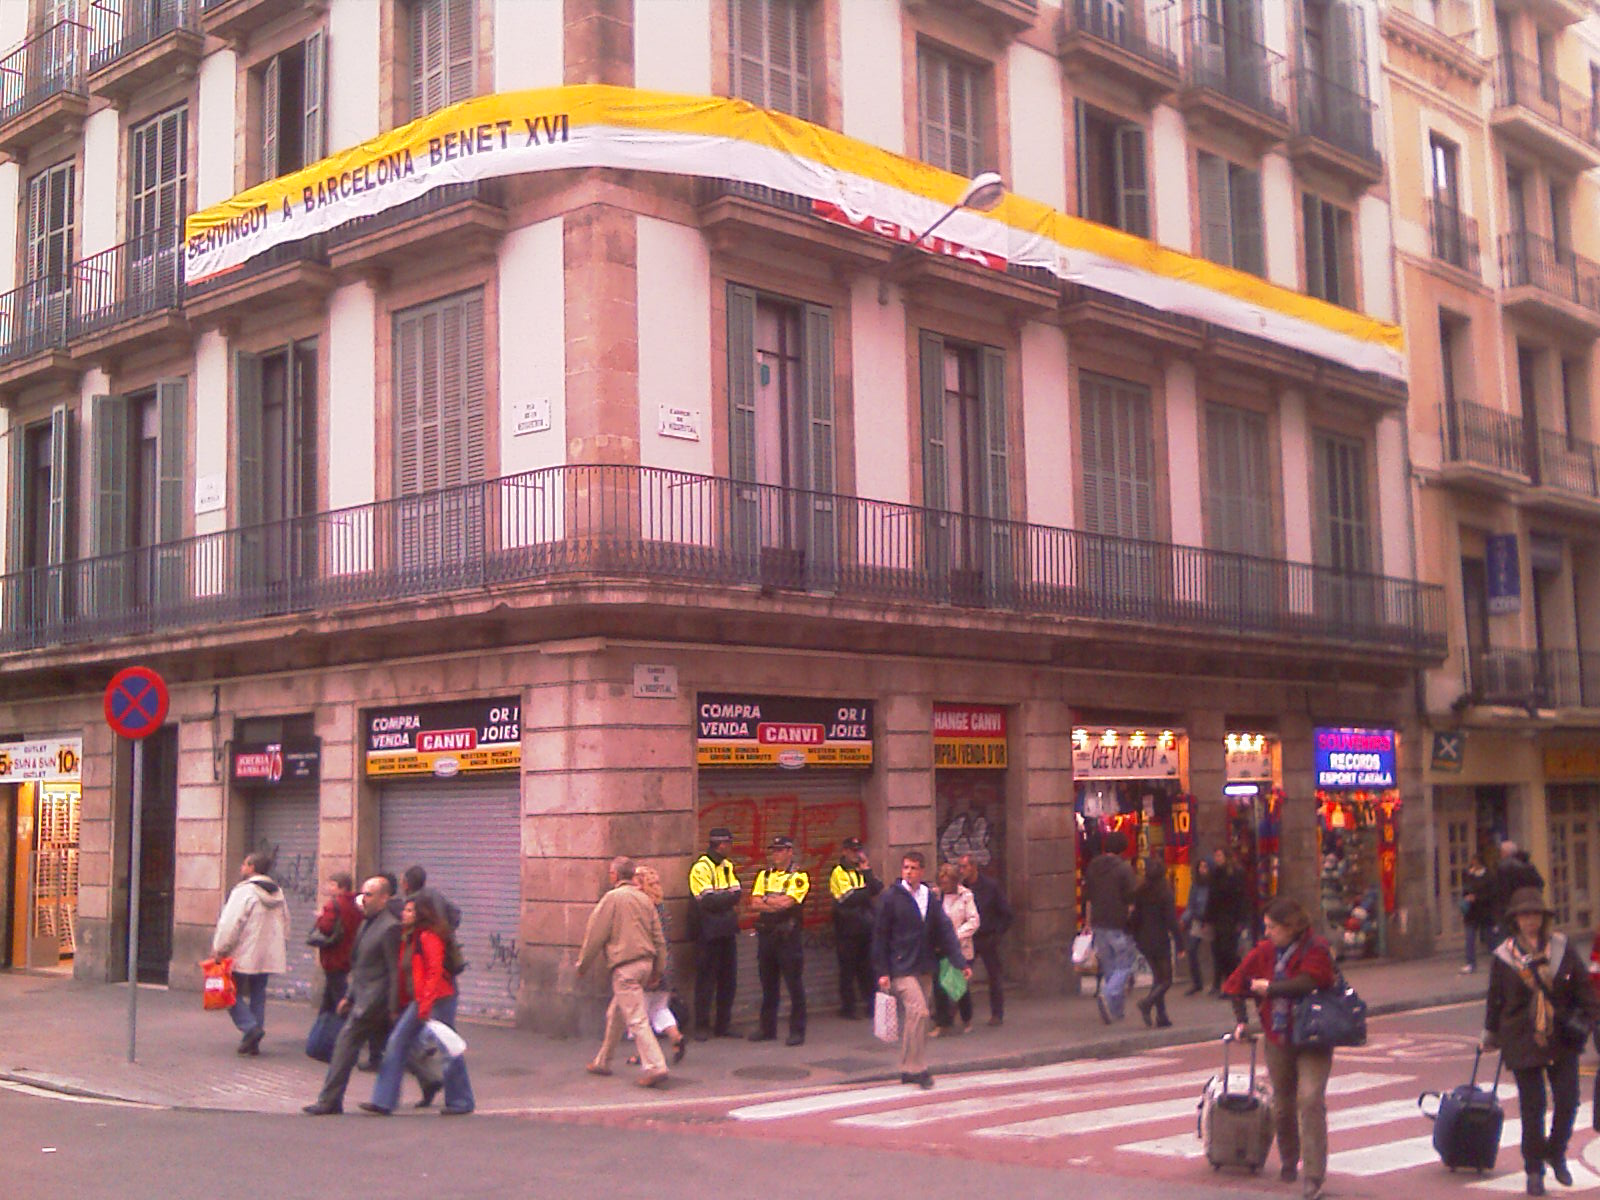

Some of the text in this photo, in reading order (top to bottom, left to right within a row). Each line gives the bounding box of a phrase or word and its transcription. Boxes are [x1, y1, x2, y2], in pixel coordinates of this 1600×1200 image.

[188, 114, 570, 260] BENVINGUT A BARCELONA BENET XVI
[489, 707, 510, 723] OR
[701, 703, 761, 719] COMPRA
[837, 707, 857, 721] OR
[372, 714, 421, 733] COMPRA
[701, 721, 749, 736] VENDA
[971, 712, 1001, 731] CANVI
[481, 725, 519, 742] JOIES
[766, 726, 818, 742] CANVI
[829, 723, 867, 738] JOIES
[372, 732, 410, 749] VENDA
[423, 732, 471, 750] CANVI
[1318, 733, 1391, 751] SOUVENIRS
[1126, 744, 1157, 769] SPORT
[1330, 752, 1381, 770] RECORDS
[1172, 811, 1190, 833] 10
